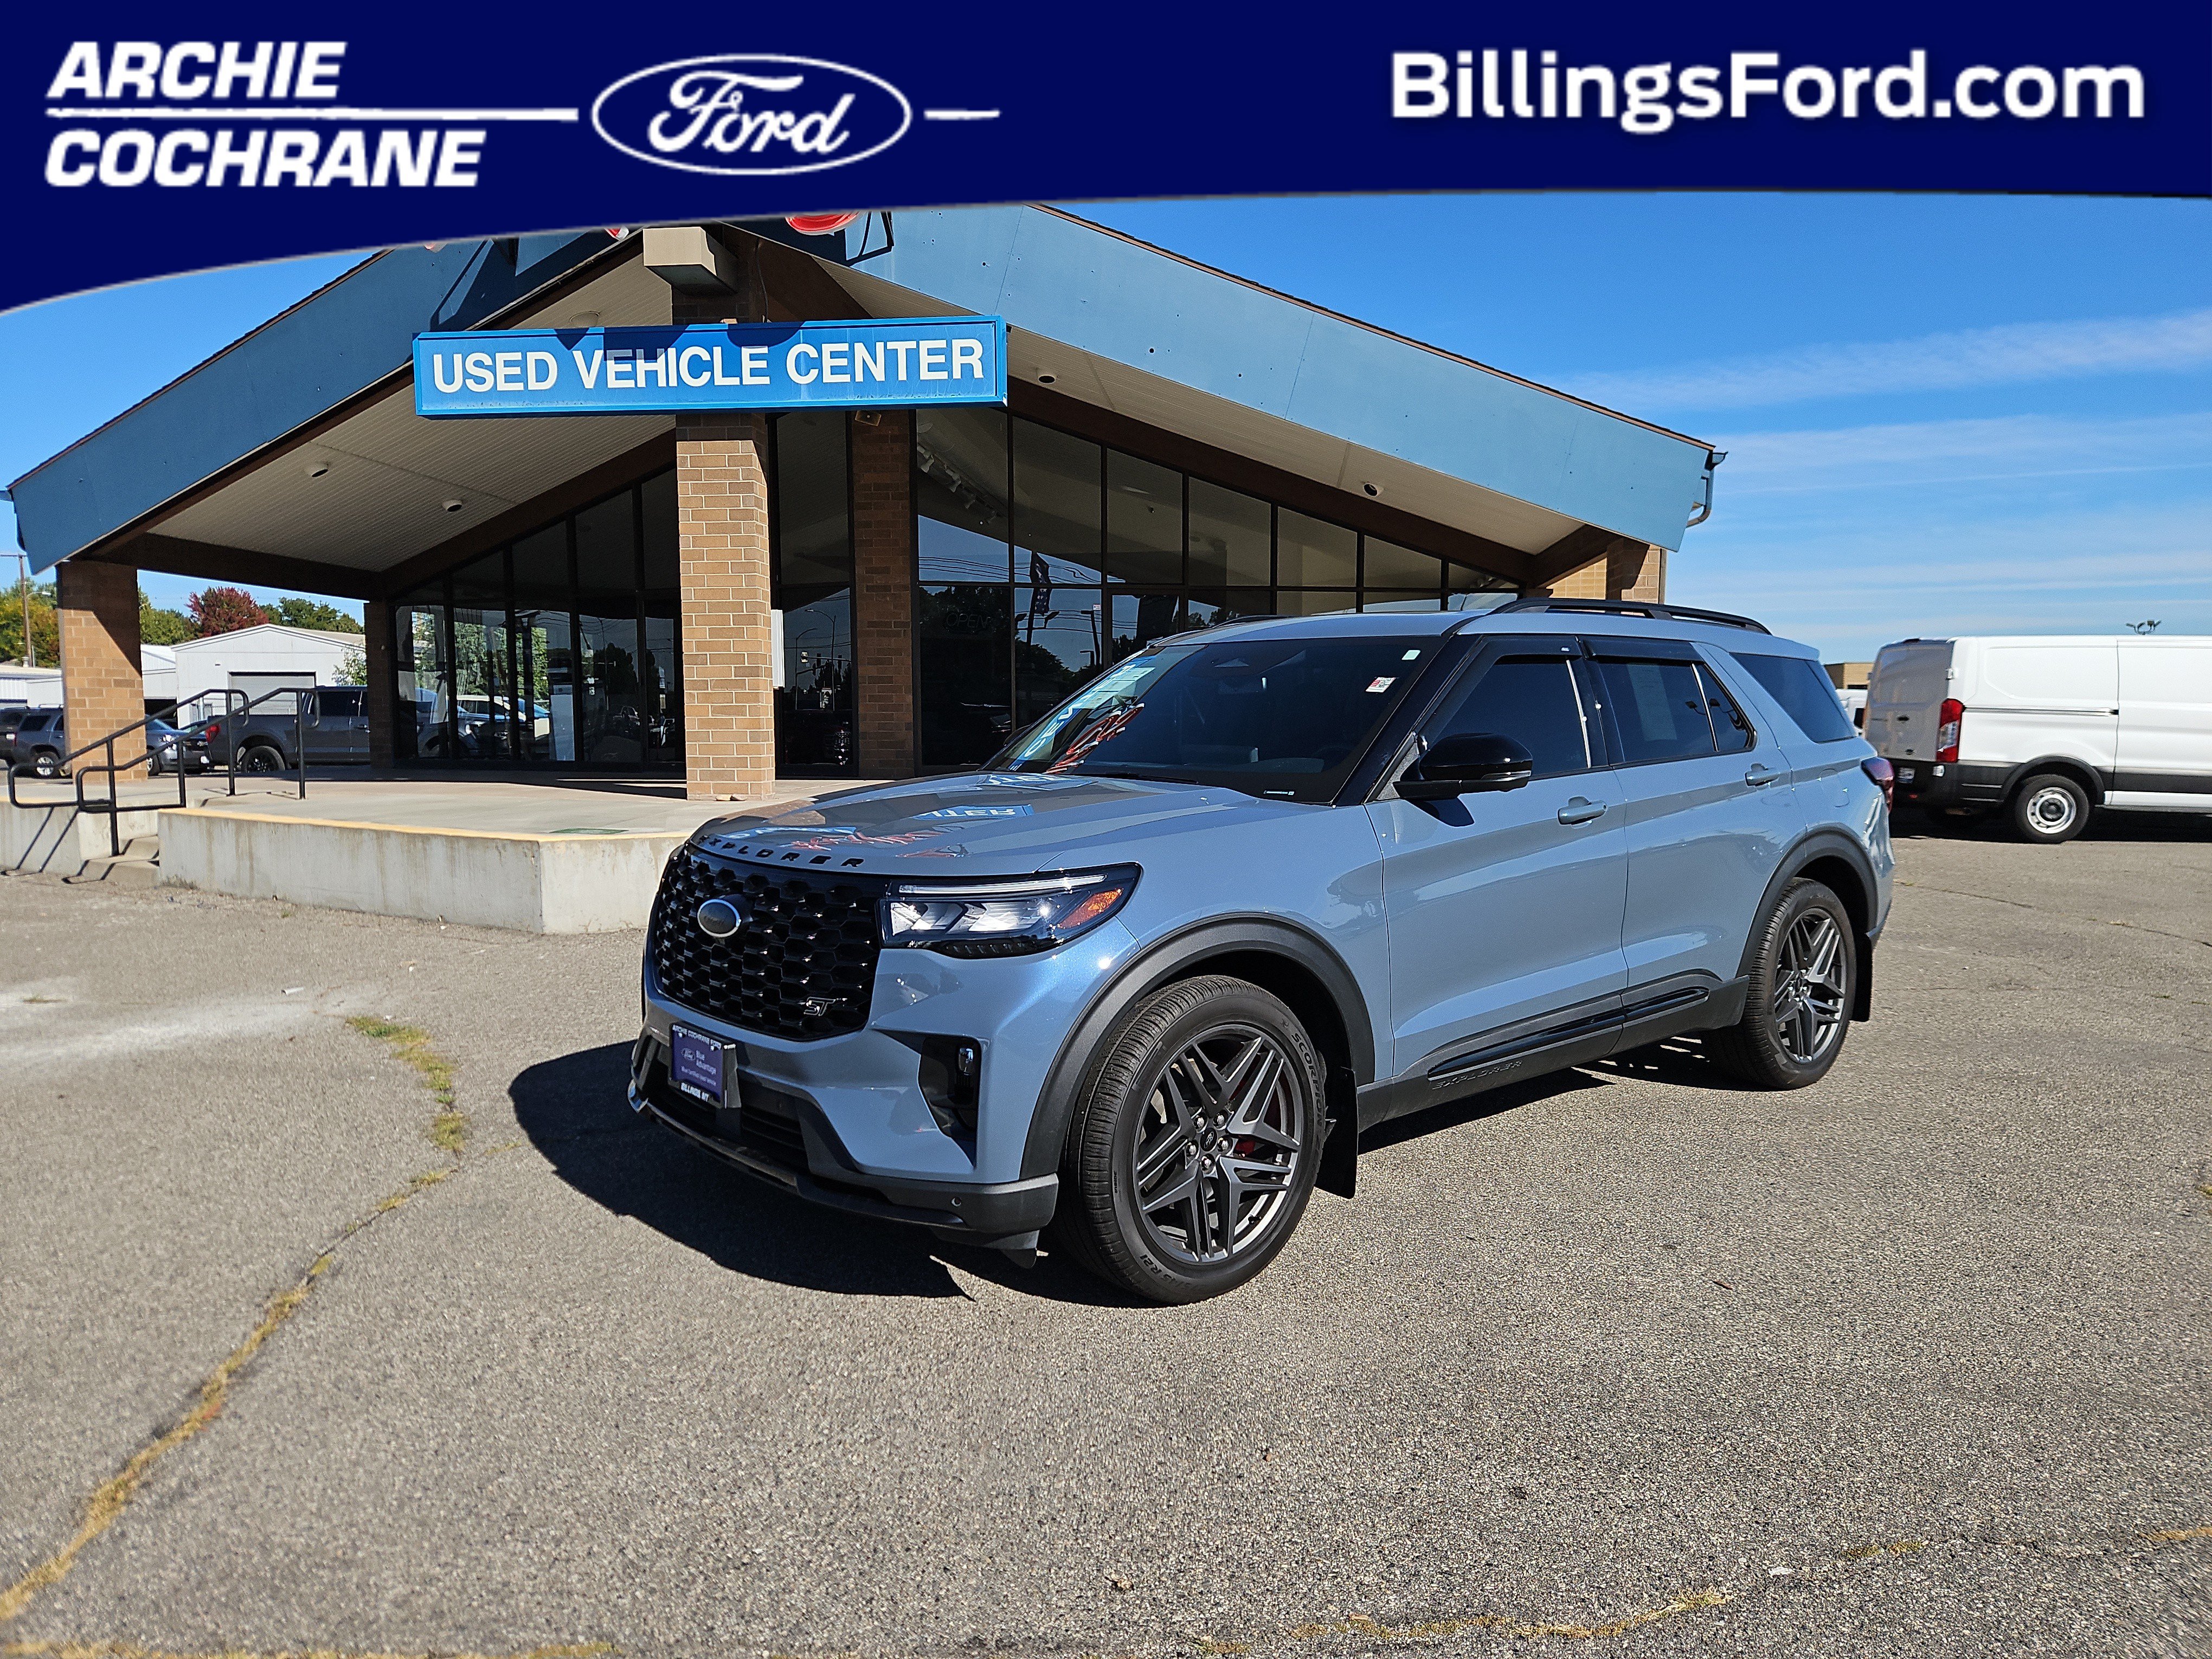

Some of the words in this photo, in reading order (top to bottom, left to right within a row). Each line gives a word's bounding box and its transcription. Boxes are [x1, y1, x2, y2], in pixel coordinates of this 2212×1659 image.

[433, 351, 557, 393] USED
[573, 345, 770, 389] VEHICLE
[786, 339, 985, 384] CENTER
[699, 835, 864, 867] EXPLORER
[803, 996, 836, 1017] ST
[1291, 1033, 1323, 1127] SCORPION
[1432, 1060, 1522, 1090] EXPLORER
